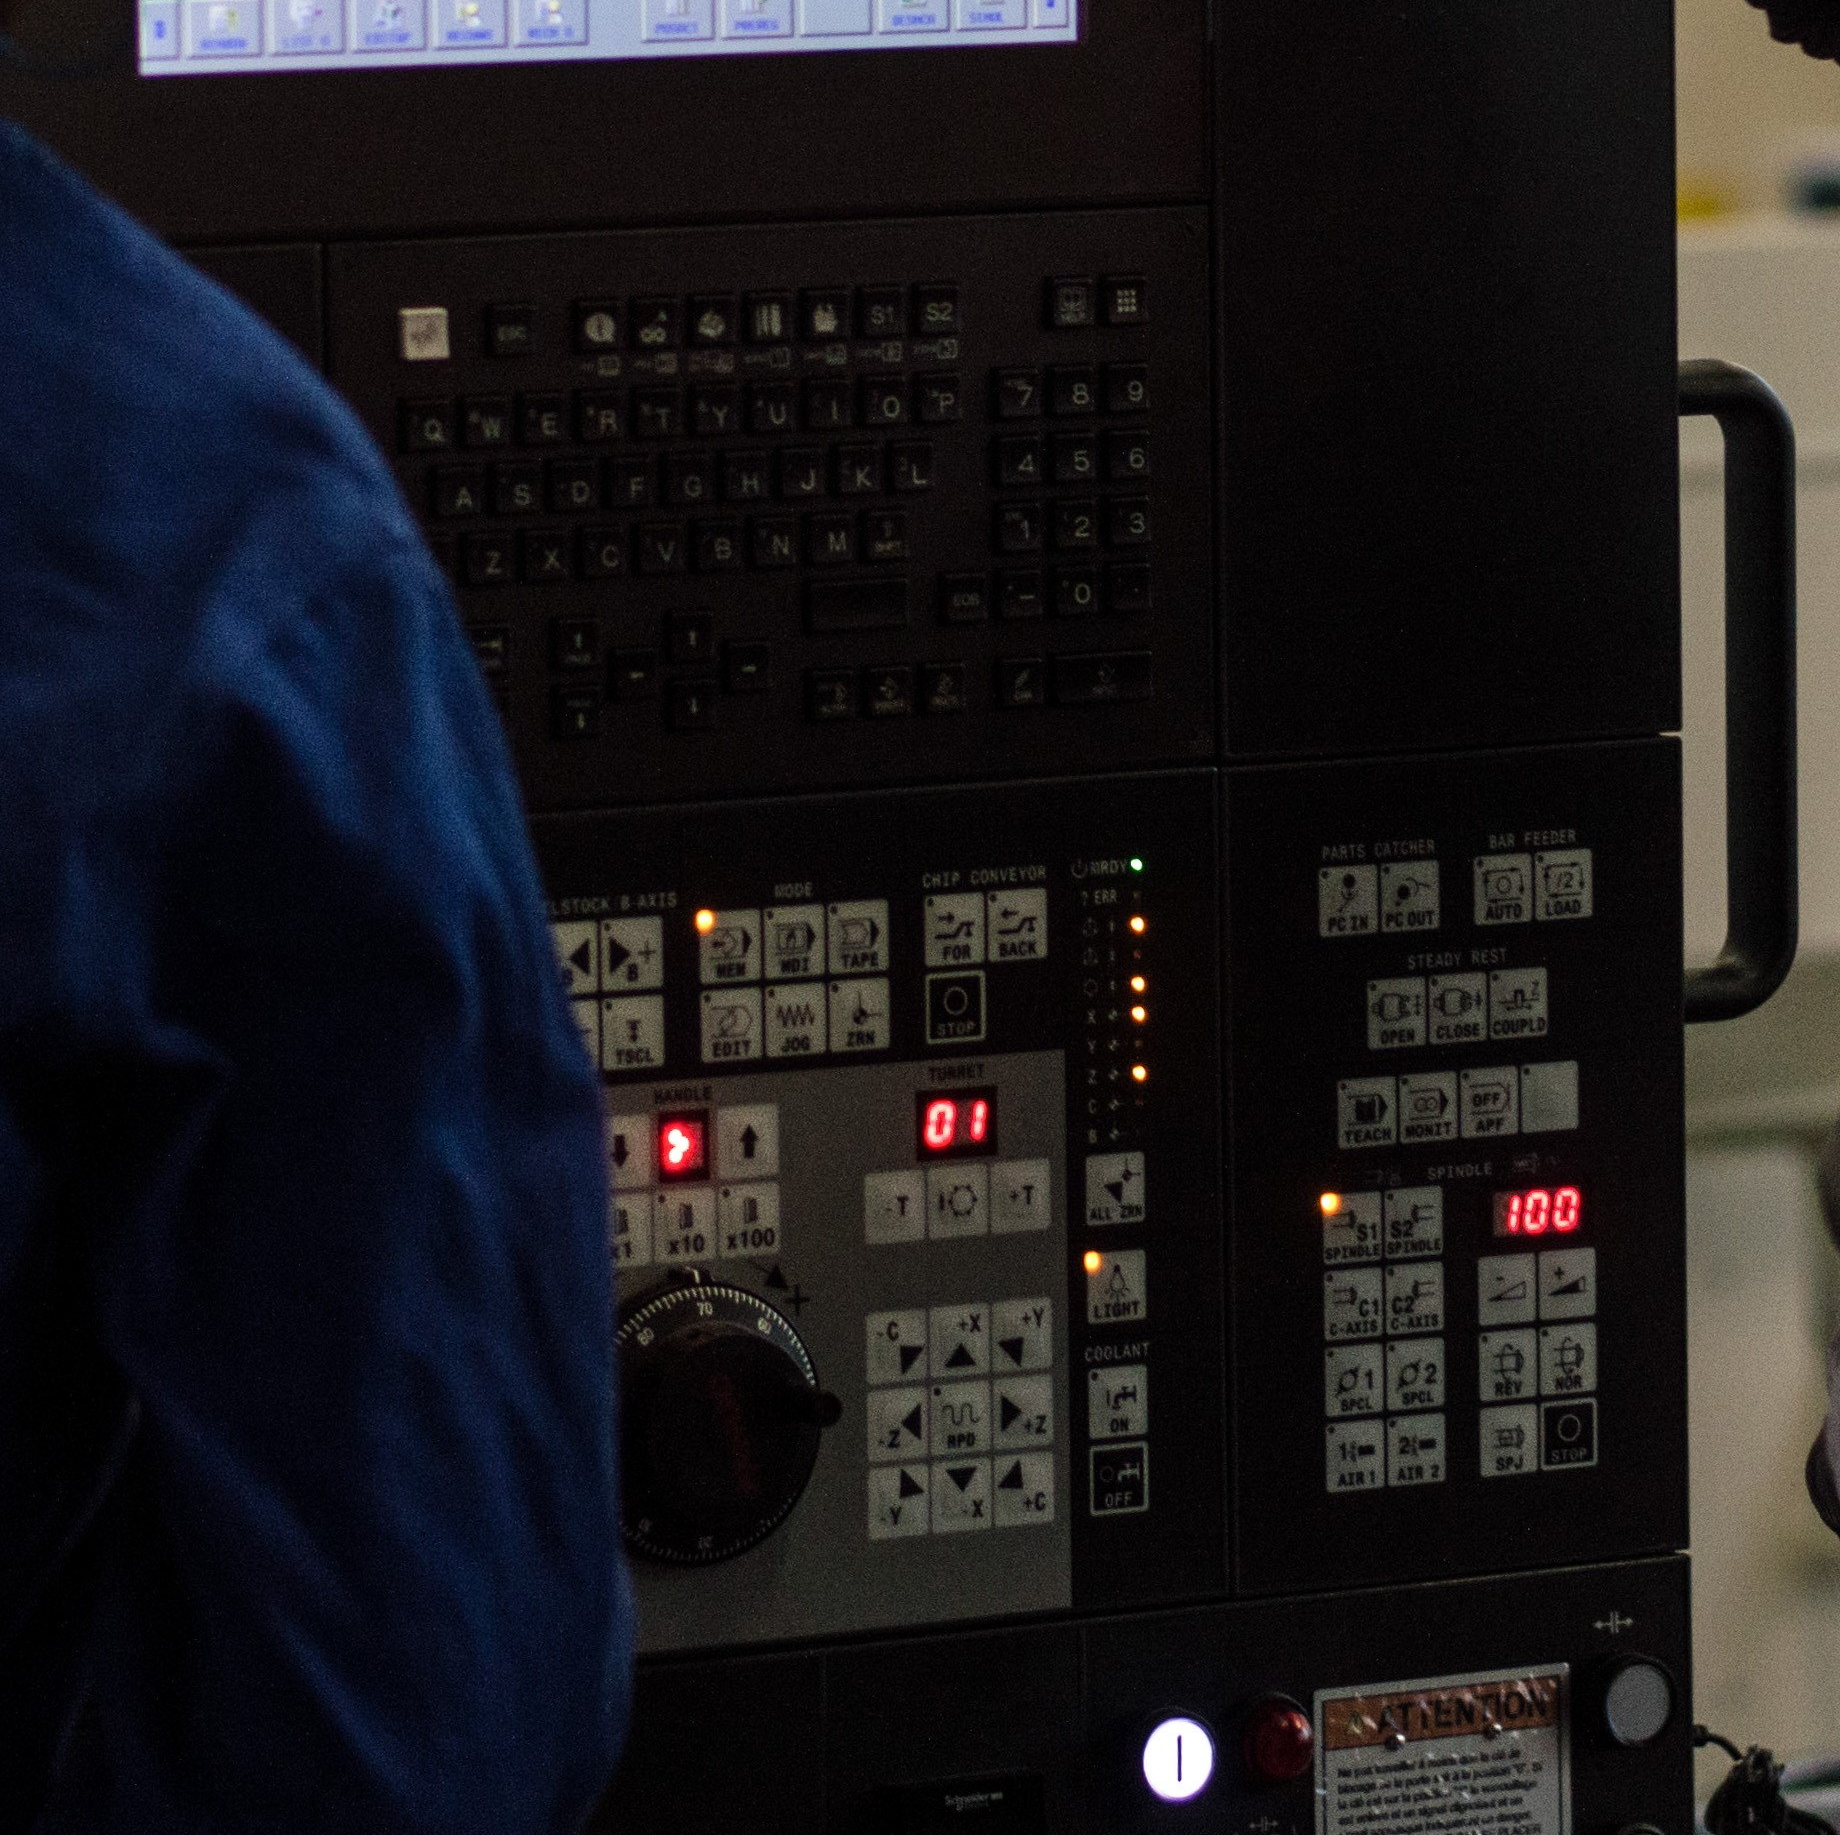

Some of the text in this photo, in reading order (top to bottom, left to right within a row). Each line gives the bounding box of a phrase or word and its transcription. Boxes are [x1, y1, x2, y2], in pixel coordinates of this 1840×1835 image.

[870, 301, 954, 325] S1 S2
[1017, 379, 1145, 407] 7 8 9
[423, 418, 445, 442] Q
[480, 415, 501, 439] W
[540, 410, 558, 436] E
[599, 408, 617, 433] R
[655, 407, 671, 429] T
[711, 405, 729, 426] Y
[768, 403, 788, 426] U
[939, 391, 956, 415] P
[1017, 446, 1146, 474] 4 5 6
[454, 463, 928, 510] A S D F G H J K L
[1020, 511, 1146, 540] 1 2 3
[485, 529, 848, 575] Z X C V B N M
[1074, 581, 1093, 606] 0
[1488, 828, 1577, 850] BAR FEEDER
[1321, 837, 1436, 862] PARTS CATCHER
[922, 864, 1048, 887] CHIP CONVEYOR
[637, 890, 679, 908] AXIS
[773, 882, 814, 899] MODE
[1093, 888, 1118, 906] ERR
[1484, 903, 1523, 921] AUTO
[1543, 899, 1582, 916] LOAD
[1327, 914, 1369, 932] PC IN
[1385, 909, 1435, 928] PC OUT
[942, 944, 972, 960] FOR
[1000, 941, 1038, 957] BACK
[1407, 946, 1508, 971] STEADY REST
[780, 957, 810, 974] MDI
[842, 951, 880, 969] TAPE
[716, 961, 747, 979] MEM
[937, 1020, 978, 1037] STOP
[1380, 1027, 1416, 1045] OPEN
[1435, 1023, 1481, 1041] CLOSE
[1492, 1018, 1547, 1037] COUPLD
[780, 1035, 812, 1053] JOG
[846, 1029, 876, 1047] ZRN
[712, 1039, 753, 1058] EDIT
[1471, 1091, 1501, 1108] OFF
[923, 1099, 989, 1148] 01
[1404, 1121, 1454, 1140] MONIT
[1476, 1117, 1504, 1134] APF
[1345, 1128, 1393, 1145] TEACH
[1426, 1163, 1494, 1182] SPINDLE
[1091, 1204, 1112, 1221] ALL
[1507, 1185, 1582, 1234] 100
[726, 1228, 777, 1250] x100
[1358, 1224, 1379, 1243] S1
[1390, 1220, 1414, 1239] S2
[668, 1234, 706, 1255] x10
[1324, 1243, 1381, 1261] SPINDLE
[1386, 1238, 1441, 1256] SPINDLE
[697, 1300, 714, 1316] 70
[1093, 1301, 1141, 1321] LIGHT
[1359, 1298, 1379, 1318] C1
[1391, 1295, 1415, 1315] C2
[958, 1313, 983, 1334] +X
[1022, 1306, 1046, 1330] +Y
[1328, 1318, 1379, 1337] C-AXIS
[1389, 1313, 1440, 1332] C-AXIS
[1083, 1340, 1151, 1363] COOLANT
[1494, 1381, 1522, 1397] REV
[1555, 1373, 1582, 1391] NOR
[1341, 1397, 1373, 1413] SPCL
[1402, 1389, 1435, 1406] SPCL
[1025, 1413, 1048, 1435] +Z
[1109, 1418, 1130, 1434] ON
[1550, 1445, 1589, 1463] STOP
[1339, 1471, 1367, 1488] AIR
[1398, 1465, 1425, 1482] AIR
[1024, 1492, 1047, 1513] +C
[1103, 1491, 1134, 1508] OFF
[1377, 1686, 1547, 1734] ATTENTION
